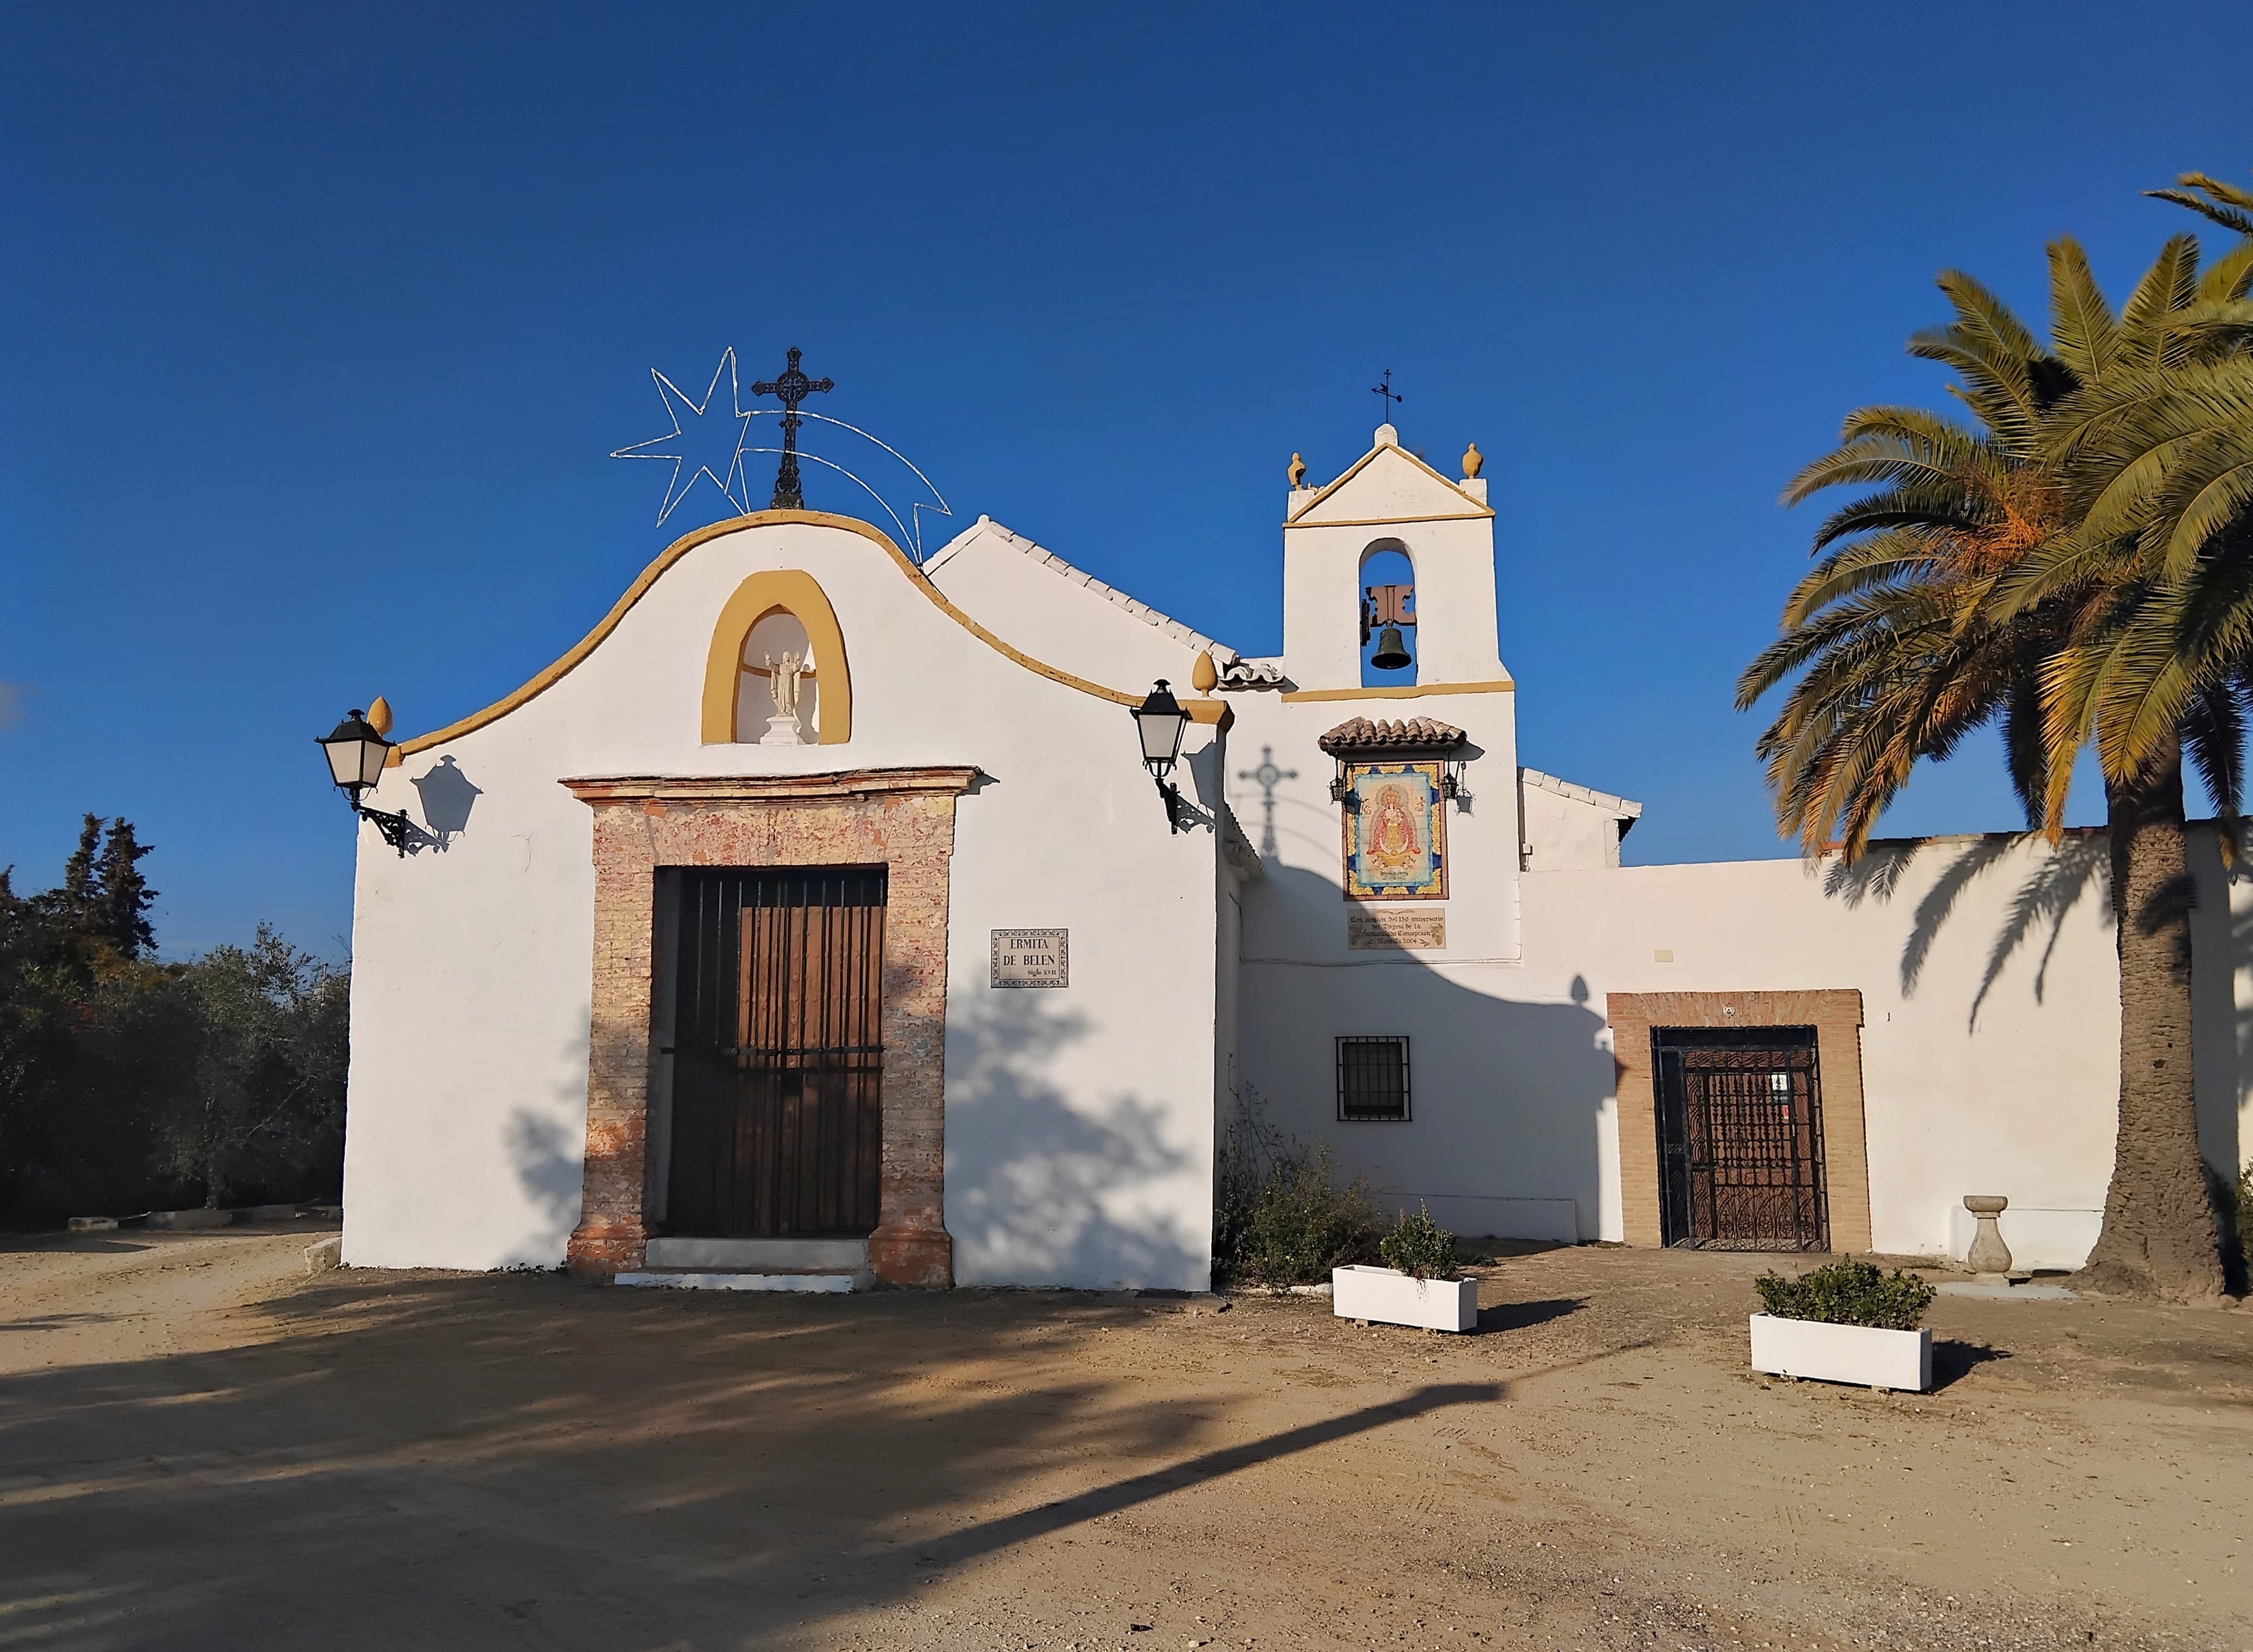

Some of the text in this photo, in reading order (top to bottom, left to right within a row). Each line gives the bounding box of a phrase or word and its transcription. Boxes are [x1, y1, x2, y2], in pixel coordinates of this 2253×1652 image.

[1011, 939, 1048, 949] ERMITA
[1004, 955, 1054, 966] DE BELEN
[1028, 969, 1042, 977] Siglo
